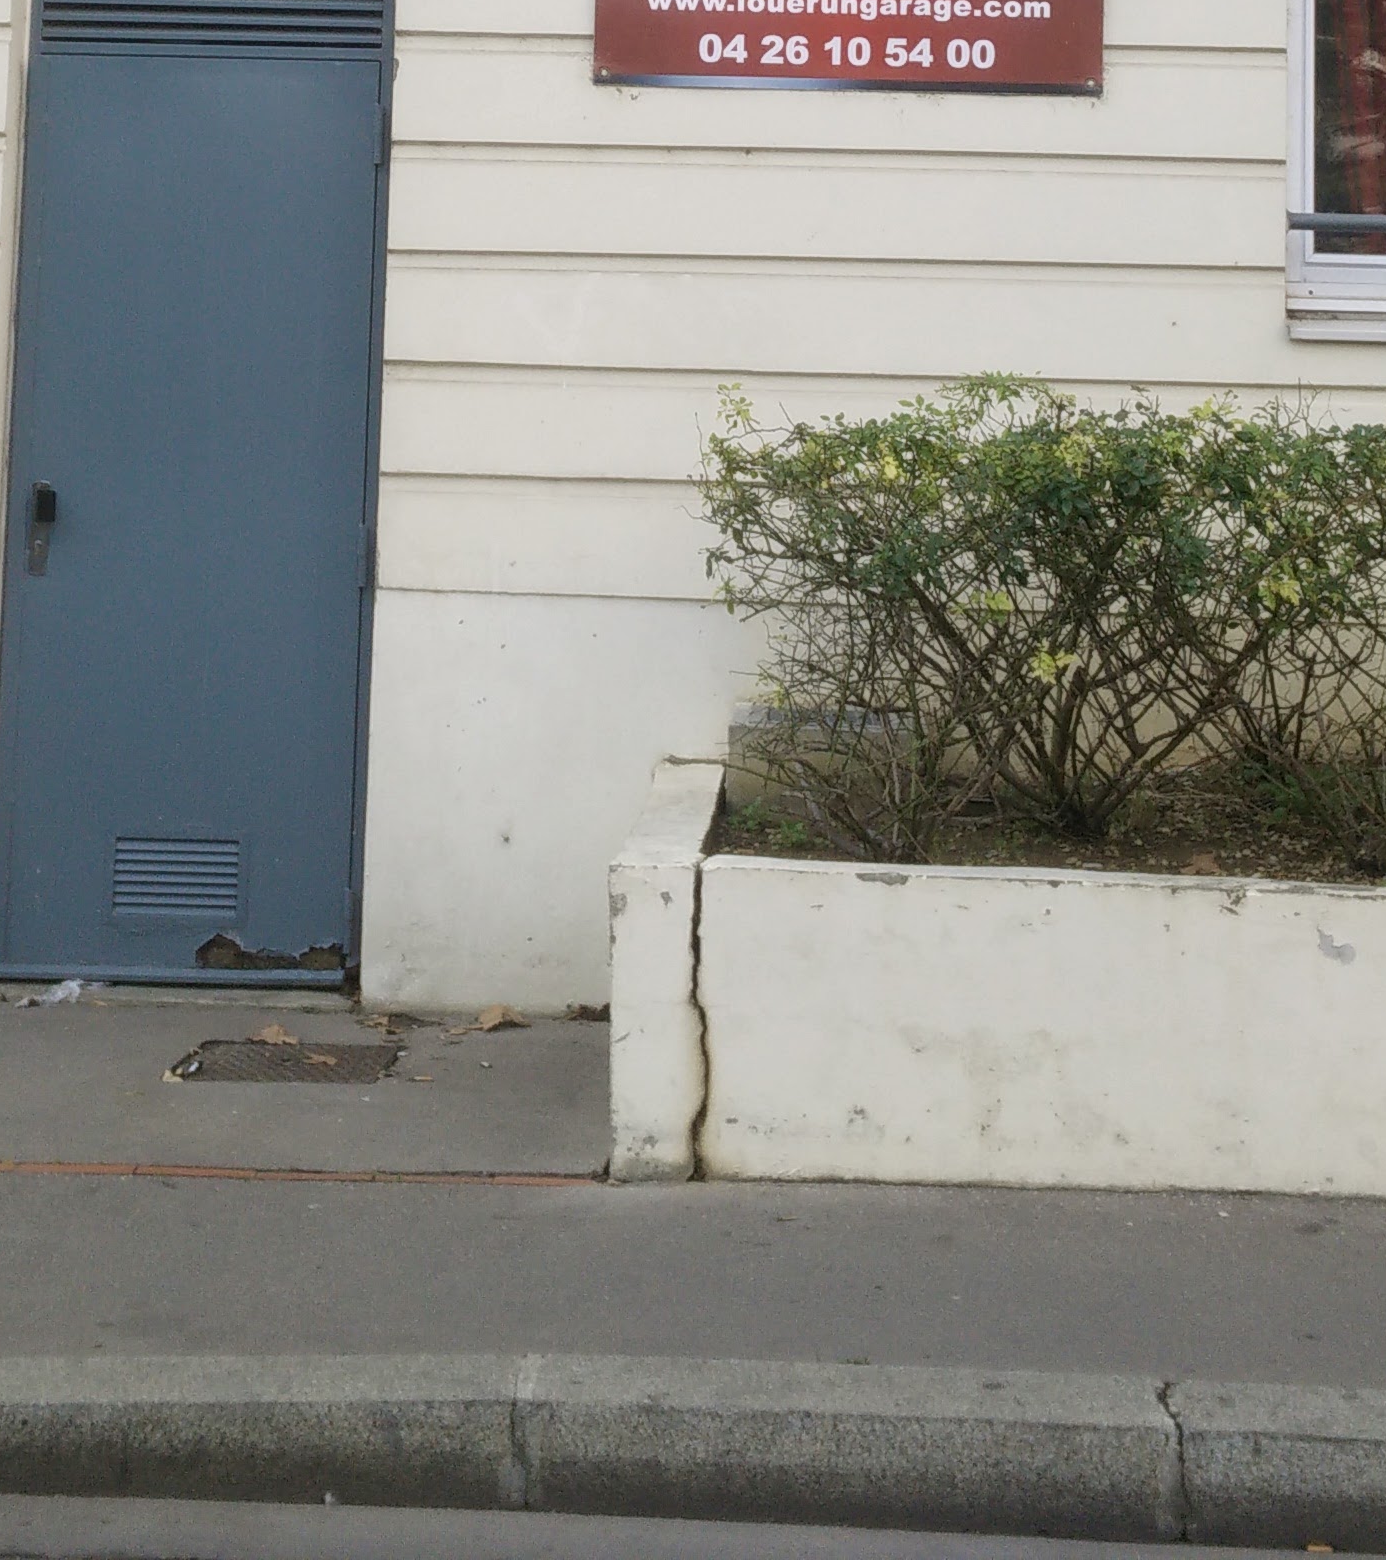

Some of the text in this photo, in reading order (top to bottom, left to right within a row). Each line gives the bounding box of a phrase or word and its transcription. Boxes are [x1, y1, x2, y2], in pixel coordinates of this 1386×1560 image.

[698, 33, 996, 69] 04 26 10 54 00
